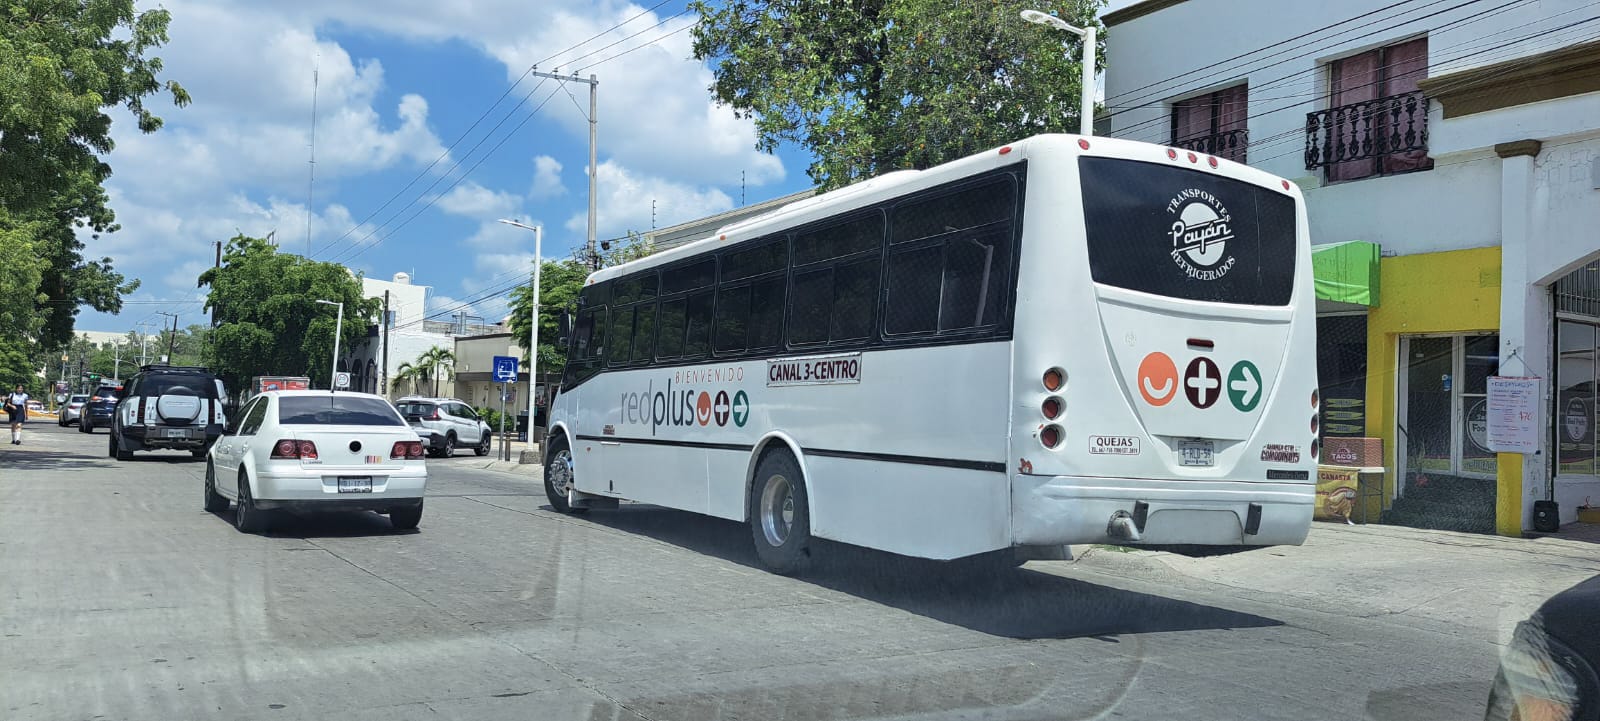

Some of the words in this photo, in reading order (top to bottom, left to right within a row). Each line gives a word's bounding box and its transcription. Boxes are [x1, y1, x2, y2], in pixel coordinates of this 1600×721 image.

[1166, 188, 1231, 223] TRANSPORTES
[1168, 221, 1231, 253] Payán
[1170, 249, 1236, 281] REFRIGERADOS
[675, 367, 745, 384] BIENVENIDO
[769, 362, 802, 383] CANAL
[804, 359, 858, 381] 3-CENTRO
[621, 378, 695, 436] redplus
[1096, 437, 1133, 447] QUEJAS
